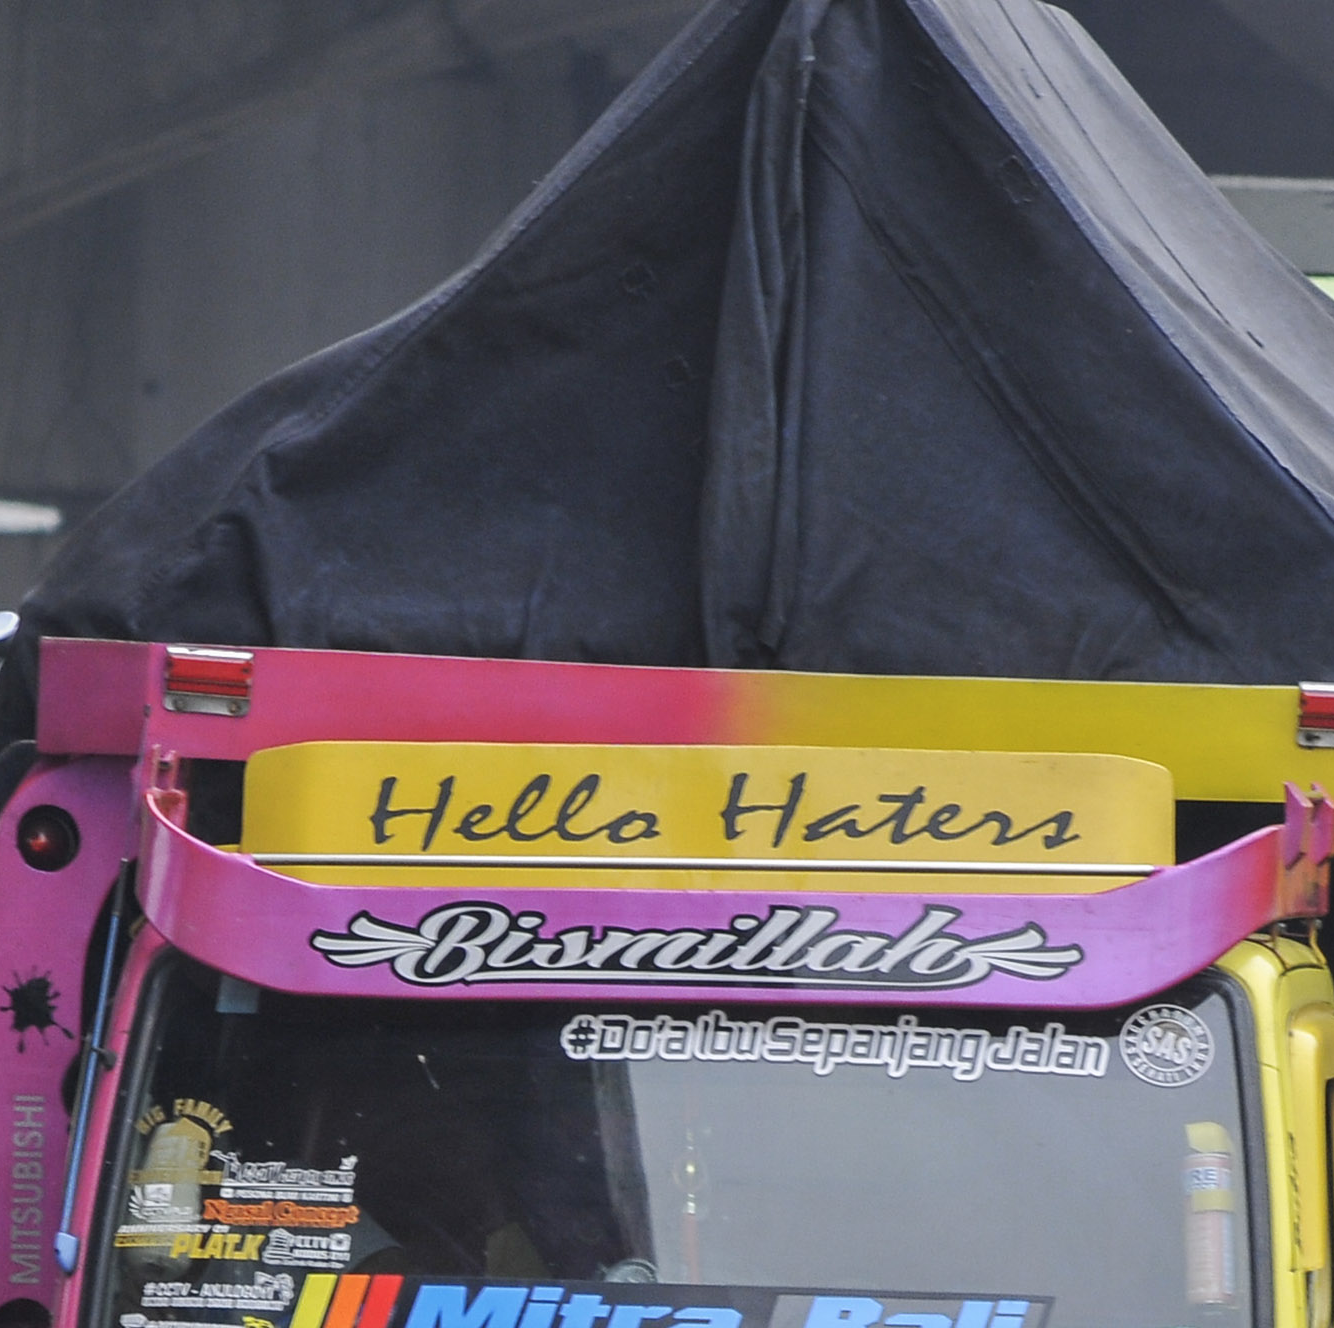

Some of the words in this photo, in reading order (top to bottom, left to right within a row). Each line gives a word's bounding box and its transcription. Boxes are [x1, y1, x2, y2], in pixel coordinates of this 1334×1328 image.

[369, 774, 662, 850] Hello
[720, 771, 1080, 850] Haters
[402, 900, 981, 985] Bismillah
[763, 1015, 988, 1081] Sepanjang
[987, 1023, 1110, 1077] Jalan
[1142, 1025, 1192, 1065] SAS
[9, 1095, 45, 1285] MITSUBISHI
